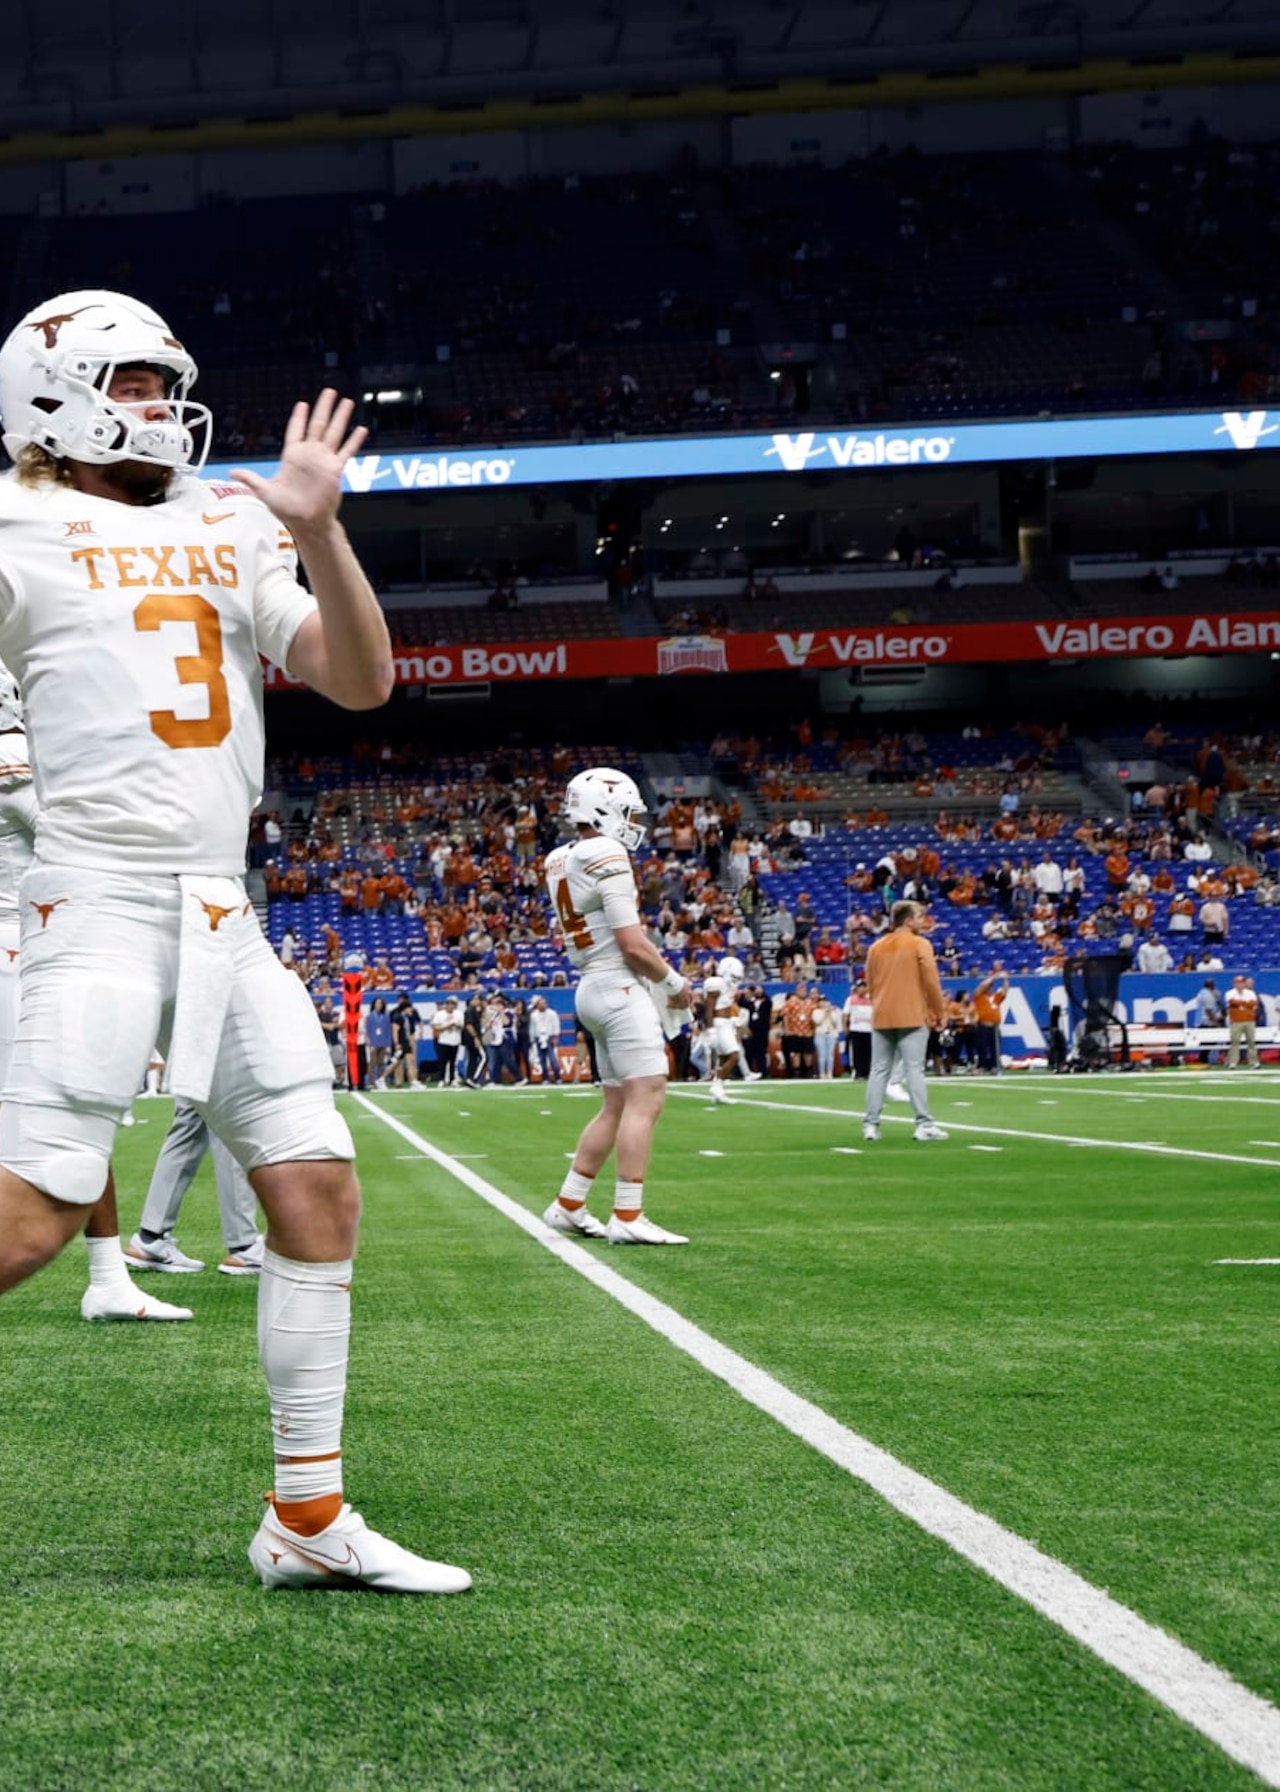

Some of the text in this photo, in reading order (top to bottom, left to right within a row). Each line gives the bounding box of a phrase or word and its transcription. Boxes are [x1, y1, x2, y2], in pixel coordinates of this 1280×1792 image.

[827, 435, 950, 465] Valero
[392, 457, 505, 487] Valero
[71, 544, 239, 590] TEXAS
[829, 634, 947, 661] Valero
[1035, 622, 1174, 653] Valero
[133, 594, 232, 750] 3
[462, 645, 567, 676] Bowl
